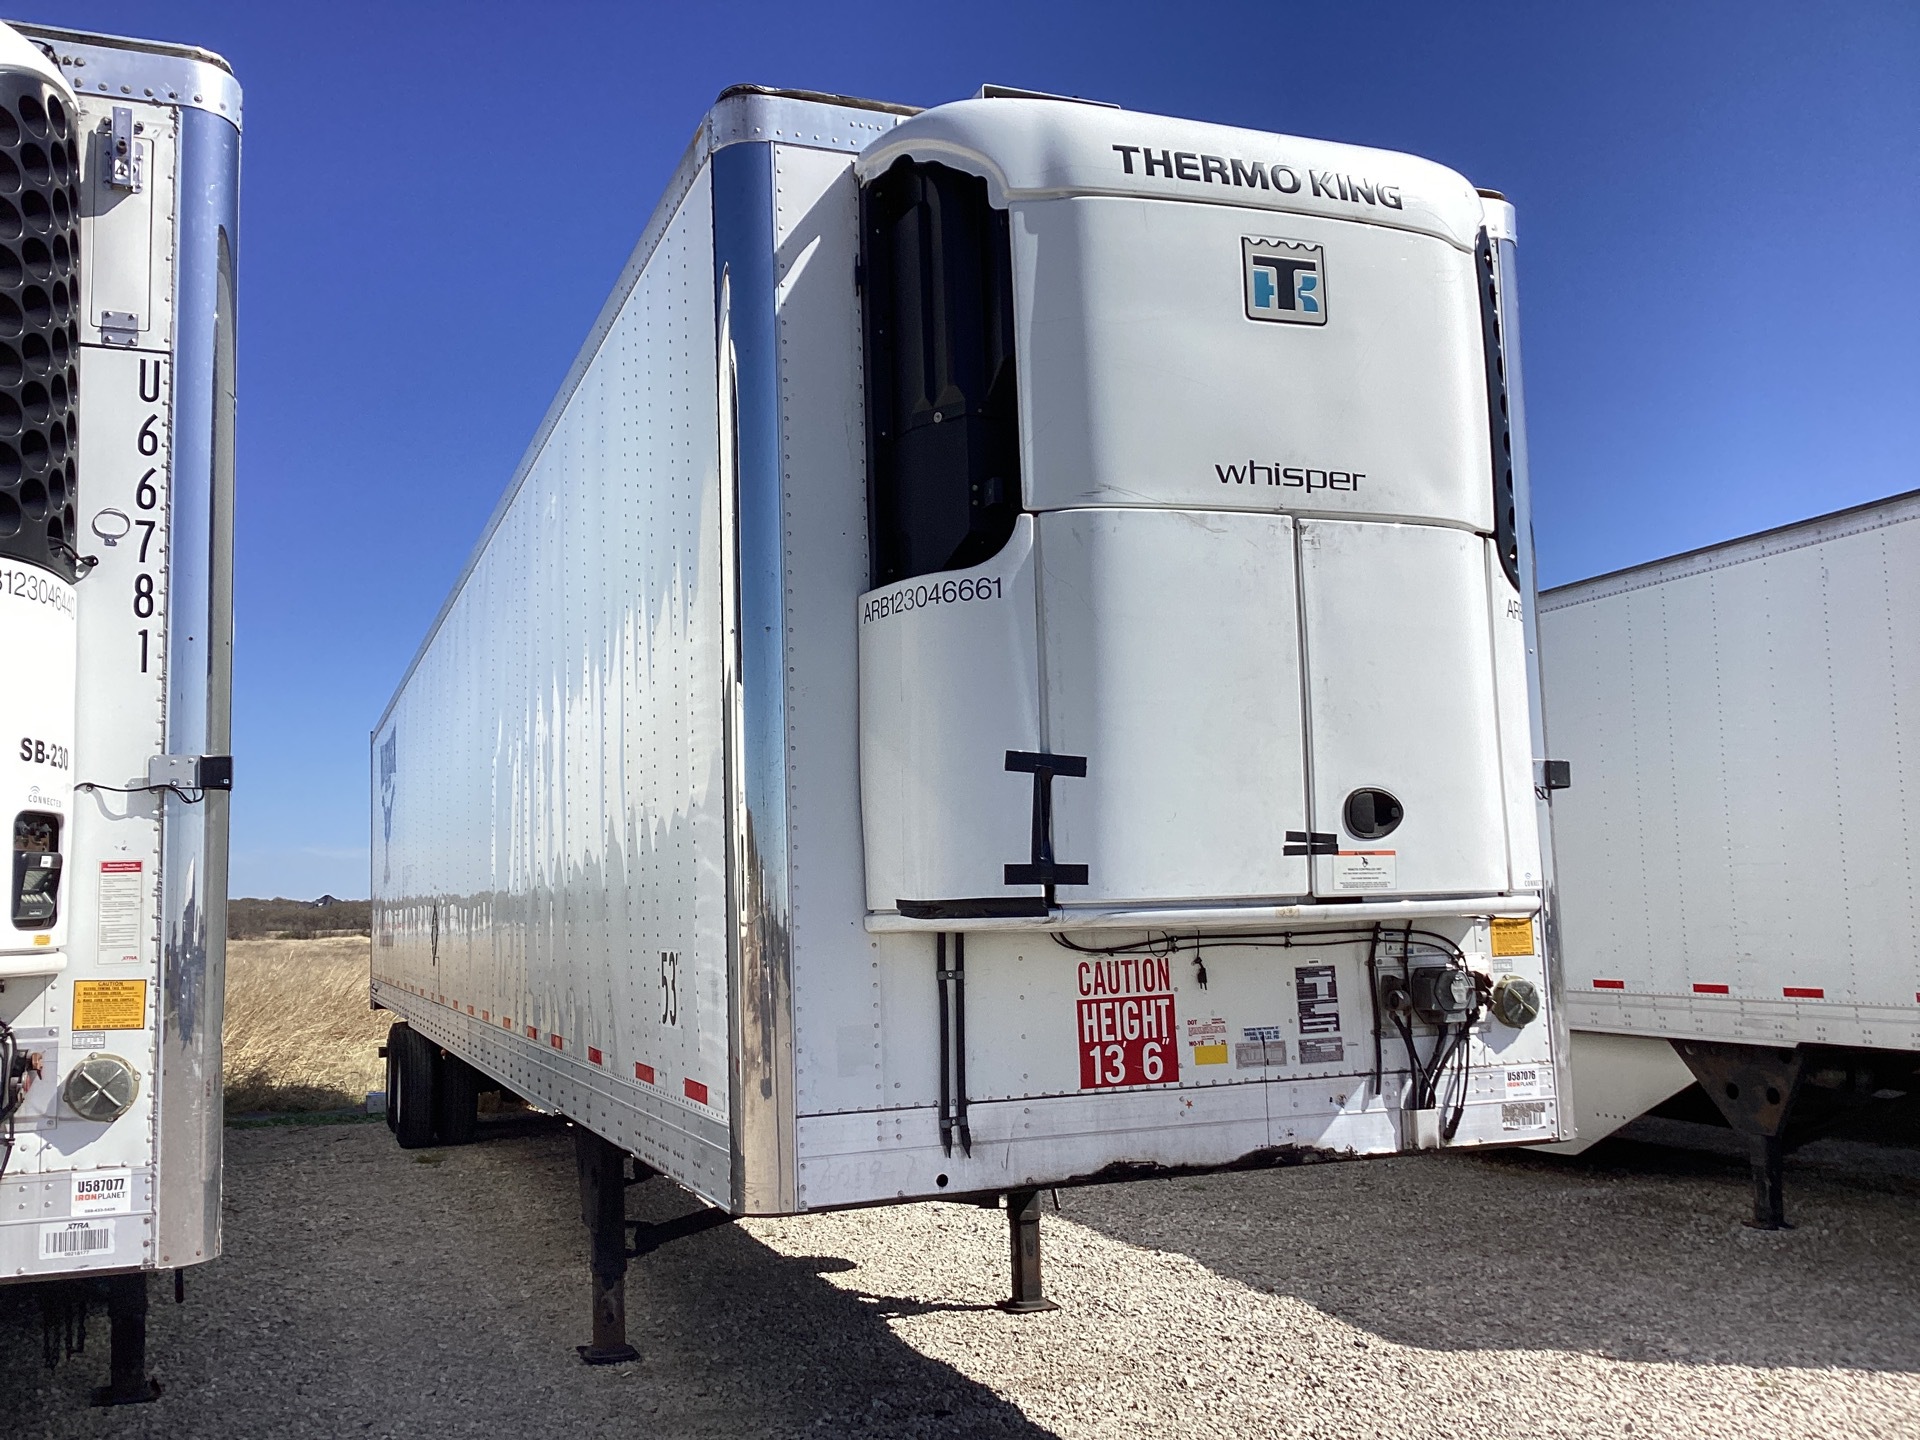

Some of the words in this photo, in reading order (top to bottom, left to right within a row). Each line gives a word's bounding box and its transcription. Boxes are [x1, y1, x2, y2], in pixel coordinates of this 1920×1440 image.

[1112, 144, 1301, 194] THERMO
[1309, 168, 1403, 210] KING
[1214, 459, 1366, 493] whisper
[0, 569, 75, 620] 123046440
[863, 577, 1003, 624] ARB123046661
[19, 737, 69, 771] SB-230
[1078, 957, 1170, 996] CAUTION
[1082, 998, 1170, 1043] HEIGHT
[1507, 1070, 1536, 1081] U587076
[78, 1178, 125, 1193] U587077
[65, 1222, 89, 1231] XTRA
